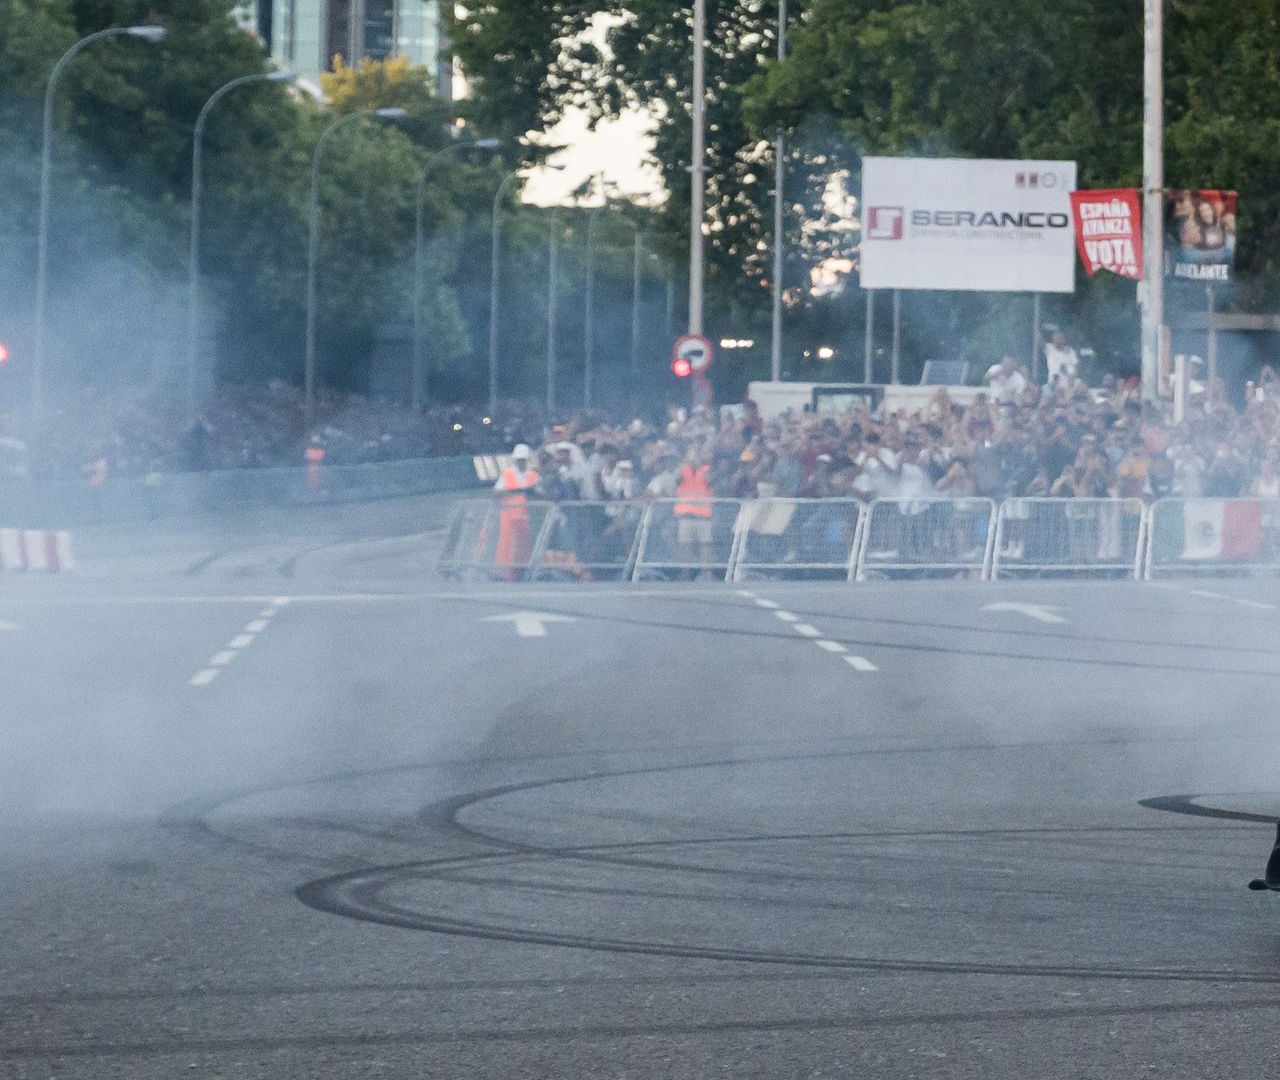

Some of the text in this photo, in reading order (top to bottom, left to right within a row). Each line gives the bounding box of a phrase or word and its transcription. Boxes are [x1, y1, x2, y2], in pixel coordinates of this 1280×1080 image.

[1079, 199, 1131, 219] ESPAÑA
[911, 210, 1068, 228] BERANCO
[1082, 219, 1132, 236] AVANZA
[1084, 239, 1135, 265] VOTA
